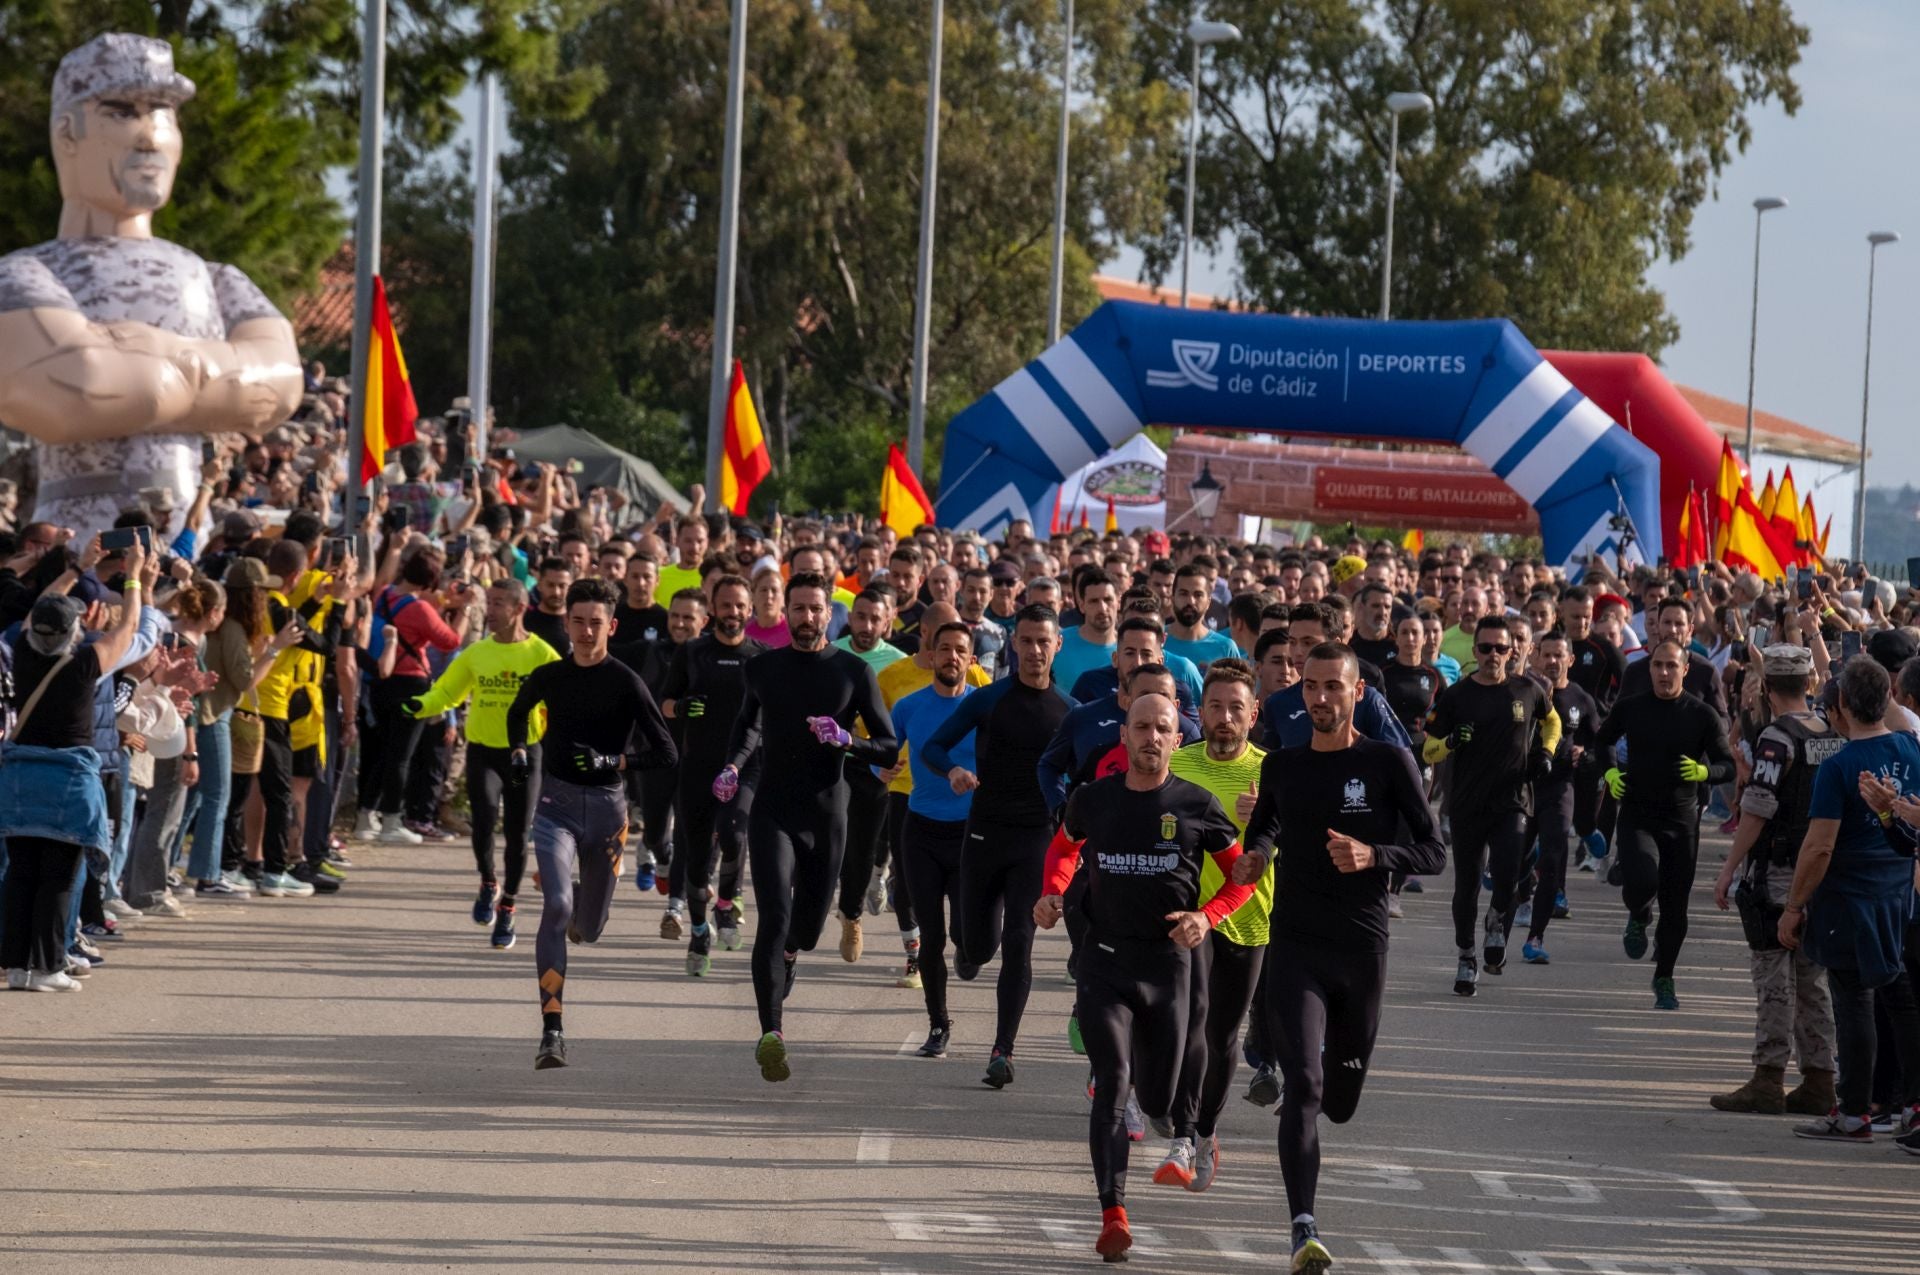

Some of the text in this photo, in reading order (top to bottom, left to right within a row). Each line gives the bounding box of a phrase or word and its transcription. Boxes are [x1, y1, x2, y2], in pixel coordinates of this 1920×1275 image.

[1229, 343, 1339, 369] Diputación
[1358, 354, 1466, 374] DEPORTES
[1228, 373, 1317, 397] de Cádiz
[1325, 482, 1517, 506] QUARTEL DE BATALLONES
[478, 675, 522, 688] Rober
[1754, 759, 1782, 786] PN
